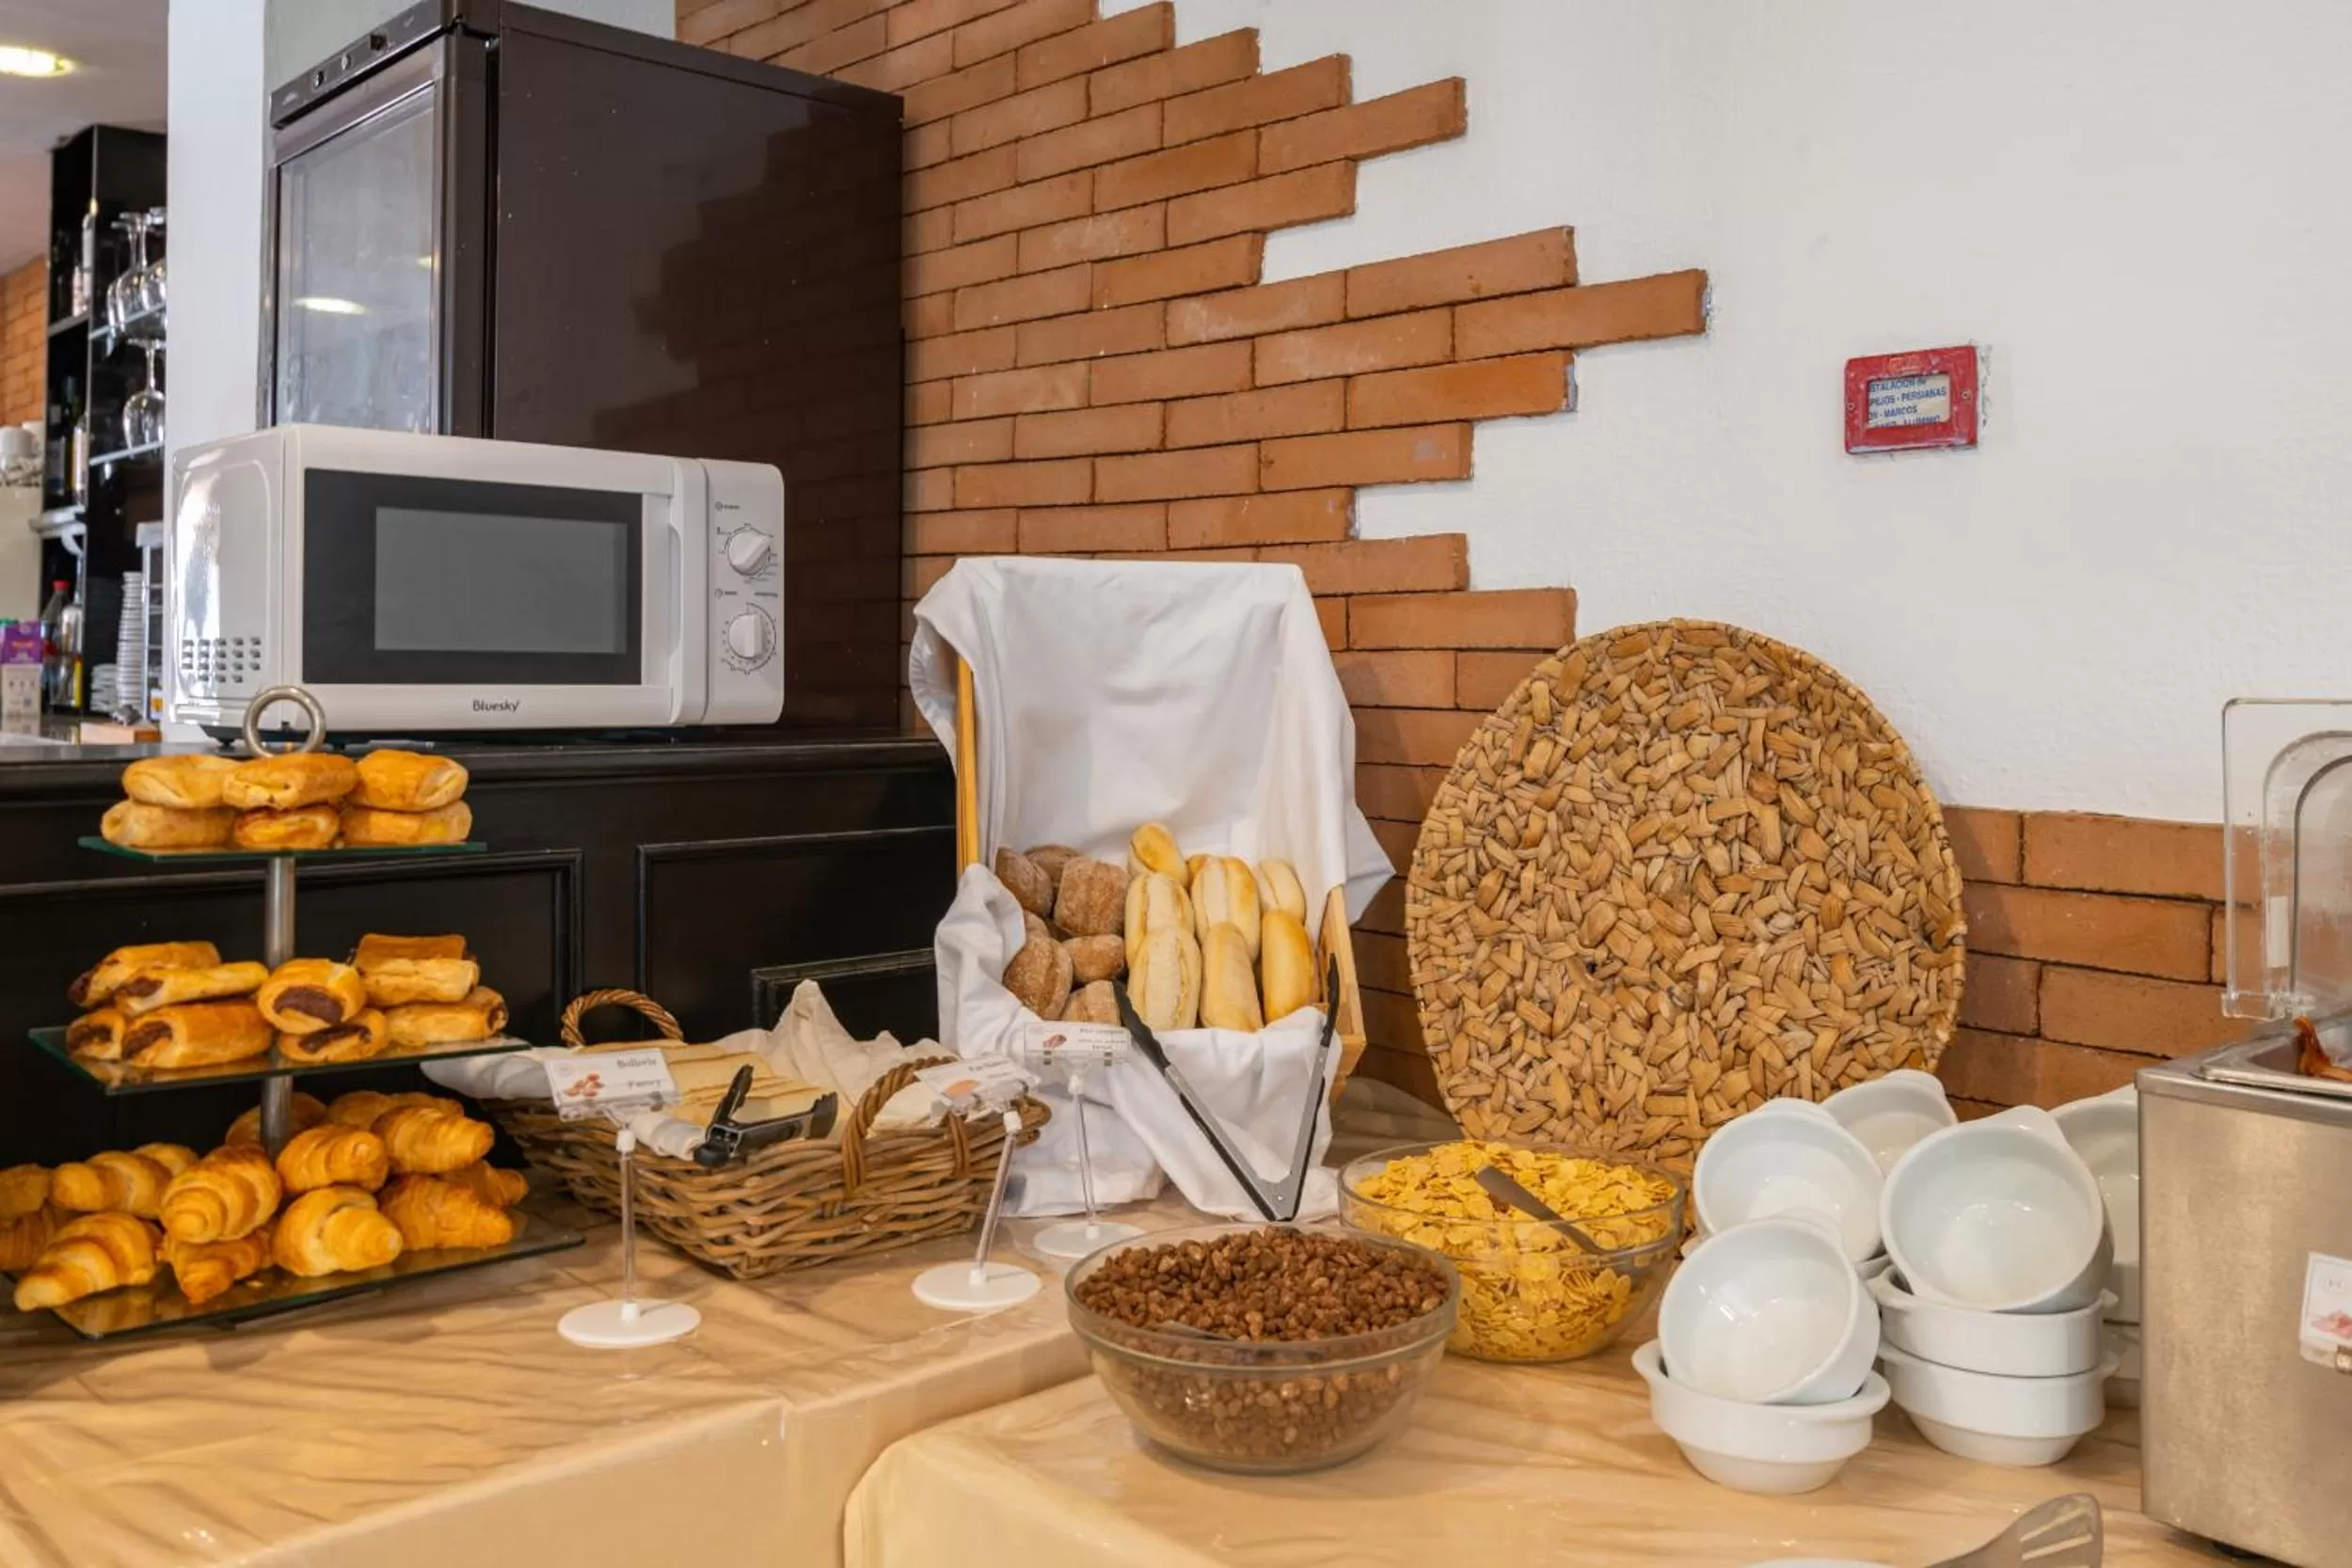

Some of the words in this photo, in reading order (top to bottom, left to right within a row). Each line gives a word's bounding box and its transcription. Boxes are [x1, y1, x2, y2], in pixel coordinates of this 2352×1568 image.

[1901, 387, 1947, 402] PERSIANAS
[1884, 405, 1917, 417] MARCOS
[473, 699, 520, 713] Bluesky
